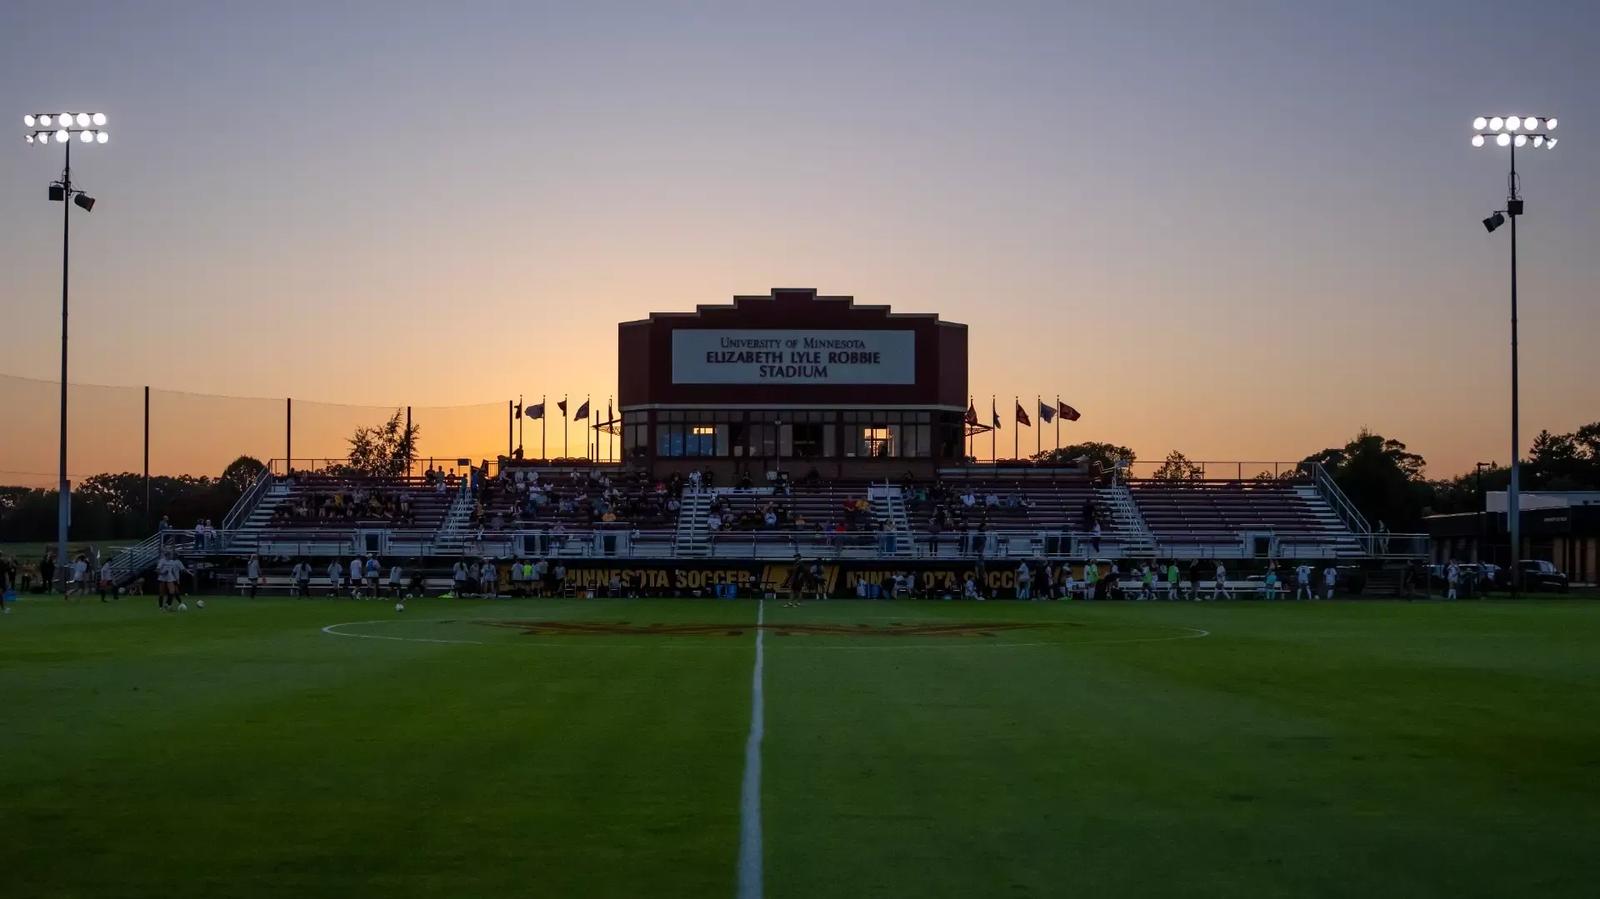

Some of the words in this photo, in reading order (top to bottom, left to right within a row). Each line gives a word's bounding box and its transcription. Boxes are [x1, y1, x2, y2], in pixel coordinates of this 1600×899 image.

[706, 351, 783, 364] ELIZABETH
[790, 351, 821, 364] LYLE
[828, 351, 881, 364] ROBBIE
[759, 365, 828, 378] STADIUM
